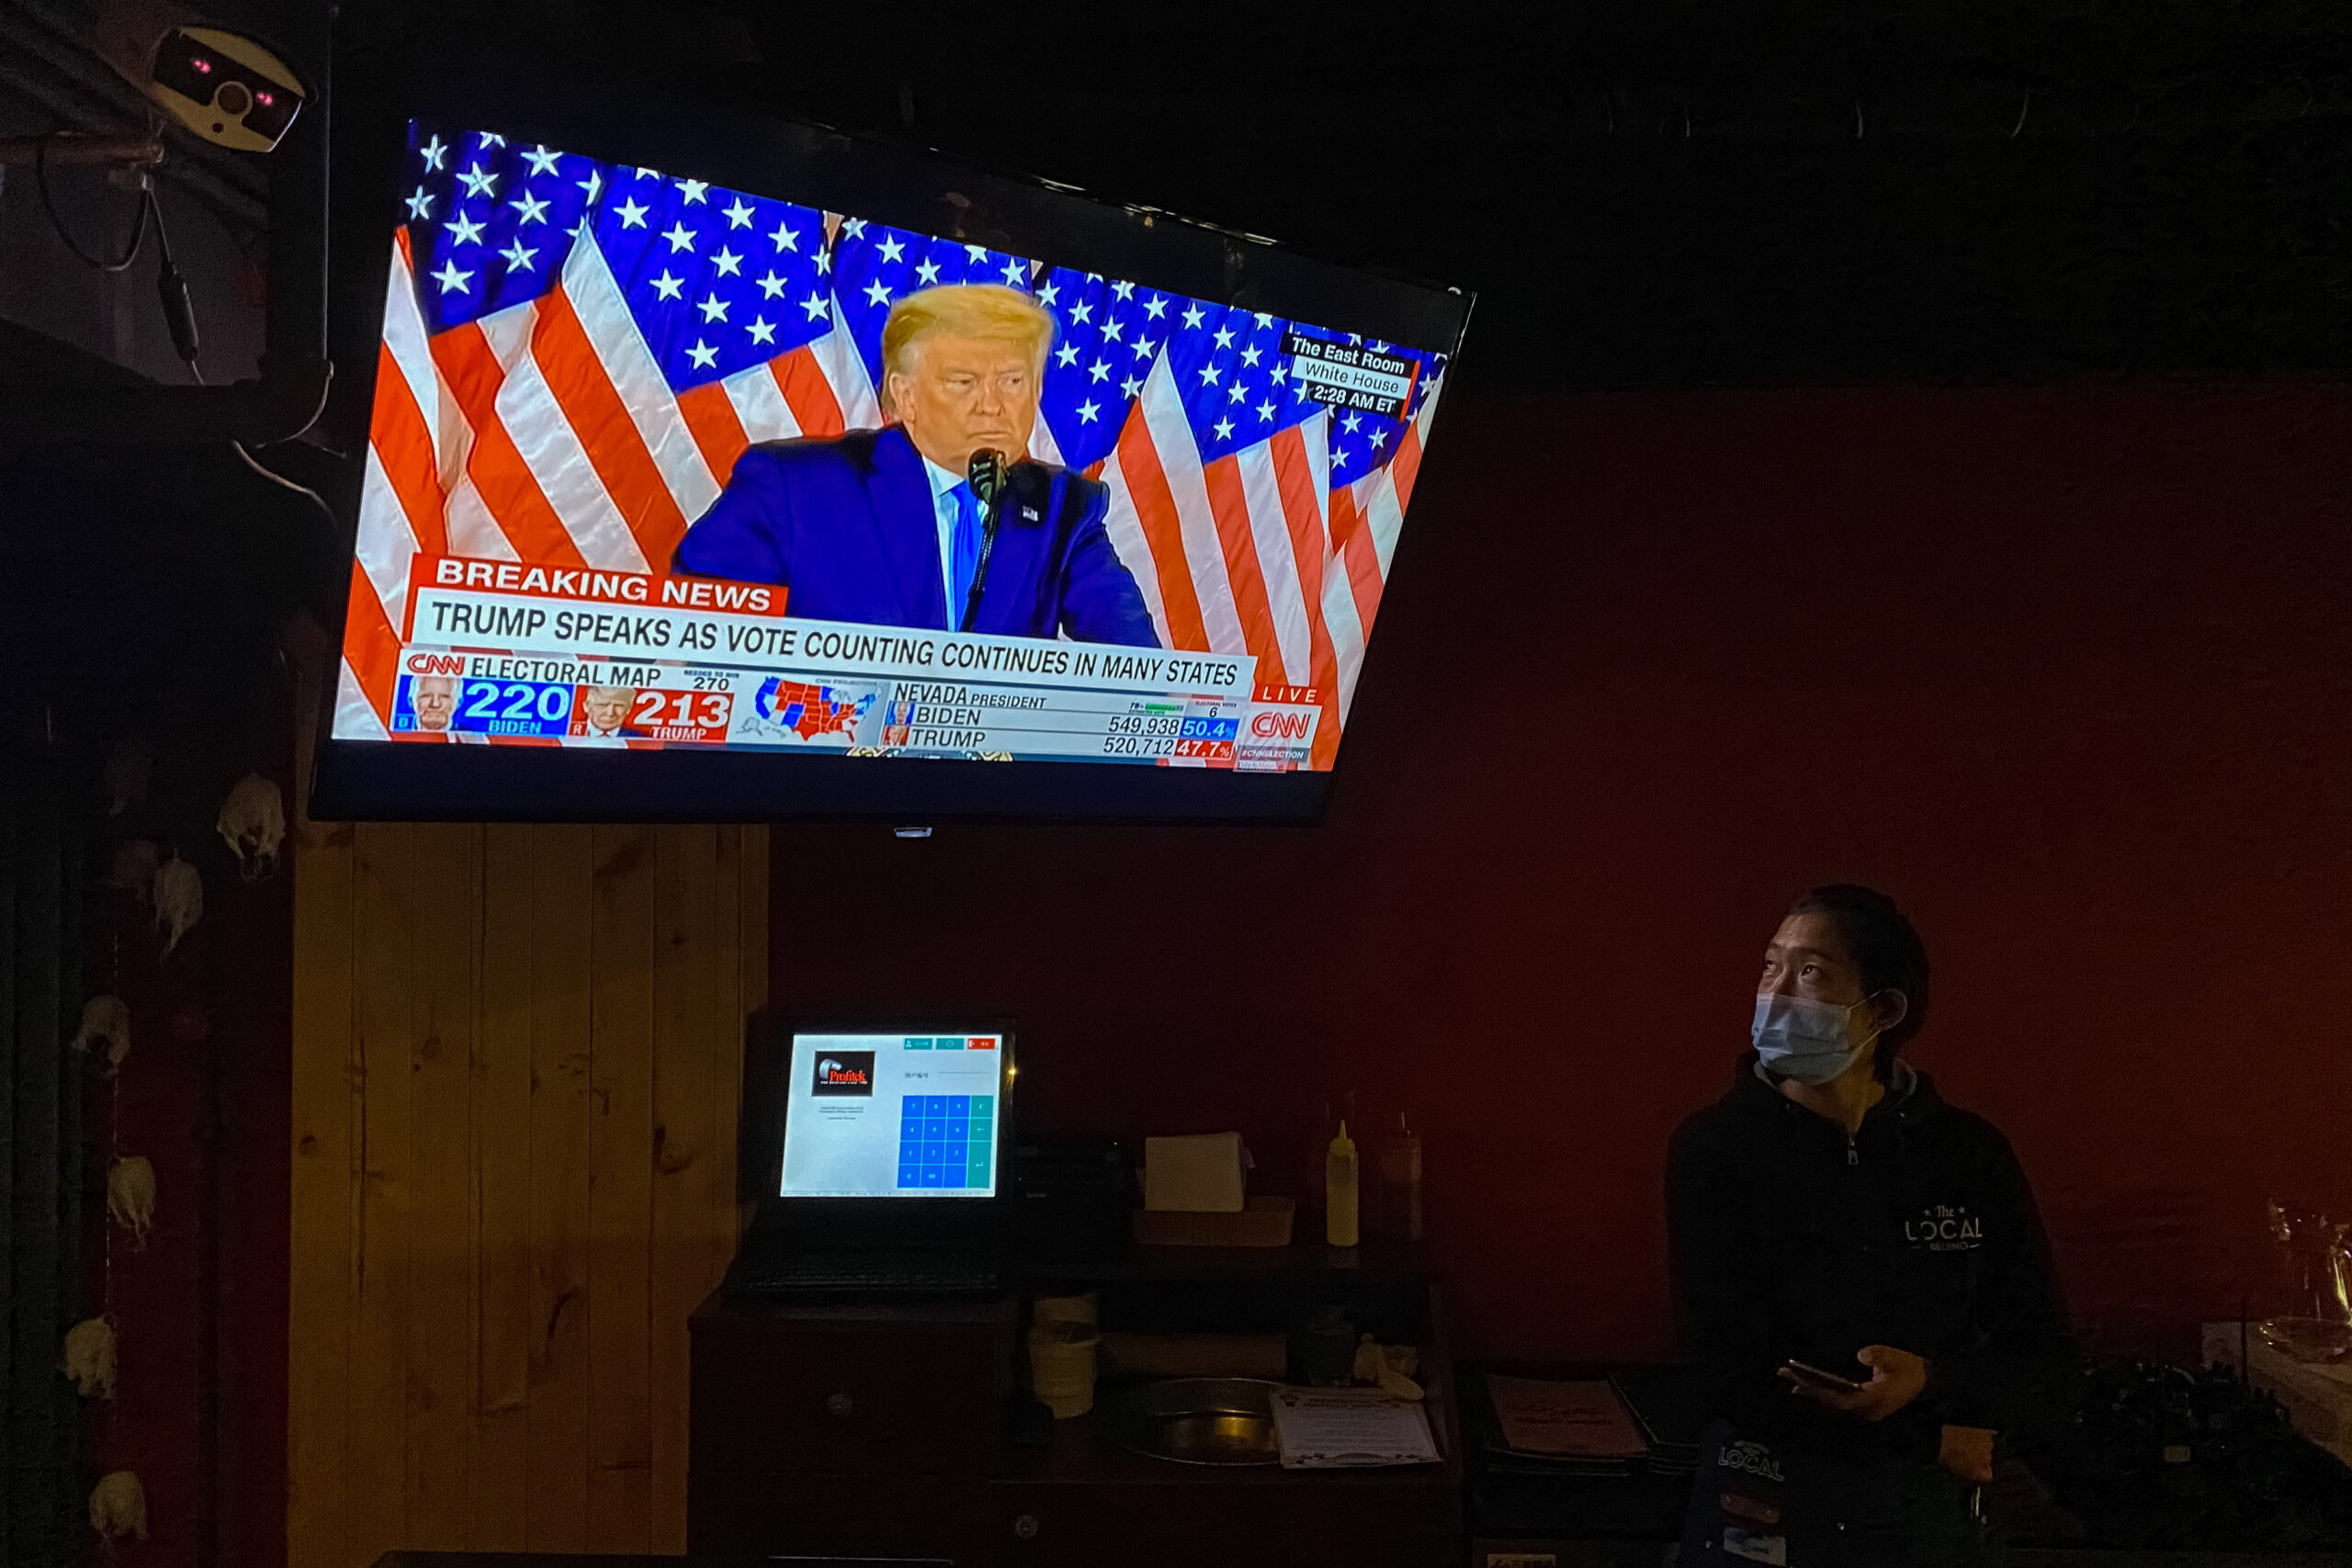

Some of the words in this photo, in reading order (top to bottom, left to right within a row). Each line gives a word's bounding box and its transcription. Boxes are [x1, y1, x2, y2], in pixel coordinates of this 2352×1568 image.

[1292, 336, 1321, 356] The
[1324, 344, 1359, 365] East
[1362, 353, 1405, 375] Room
[1306, 362, 1349, 379] White
[1352, 372, 1399, 393] House
[1314, 385, 1347, 404] 2:28
[1349, 392, 1374, 410] AM
[1376, 399, 1396, 412] ET
[436, 558, 648, 602] BREAKING
[662, 580, 772, 612] NEWS
[432, 602, 546, 637] TRUMP
[554, 611, 672, 647] SPEAKS
[678, 621, 718, 649] AS
[728, 625, 797, 656] VOTE
[804, 631, 934, 665] COUNTING
[941, 642, 1069, 675] CONTINUES
[1074, 652, 1097, 677] IN
[1102, 655, 1164, 681] MANY
[1166, 660, 1238, 686] STATES
[407, 654, 466, 675] CNN
[471, 658, 604, 685] ELECTORAL
[609, 666, 662, 687] MAP
[693, 676, 729, 691] 270
[465, 682, 571, 721] 220
[894, 682, 966, 705] NEVADA
[970, 694, 1046, 708] PRESIDENT
[1262, 685, 1317, 703] LIVE
[634, 691, 730, 728] 213
[916, 706, 980, 726] BIDEN
[1209, 707, 1218, 717] 6
[489, 720, 542, 733] BIDEN
[572, 725, 582, 735] R
[651, 726, 707, 739] TRUMP
[1108, 716, 1180, 736] 549,938
[1182, 720, 1235, 739] 50.4%
[1251, 712, 1311, 739] CNN
[911, 728, 986, 748] TRUMP
[1102, 737, 1174, 756] 520,712
[1177, 739, 1230, 757] 47.7%
[829, 1069, 866, 1081] Profitek
[1934, 1205, 1954, 1217] The
[1905, 1217, 1983, 1241] LOCAL
[1718, 1447, 1784, 1482] LOCAL
